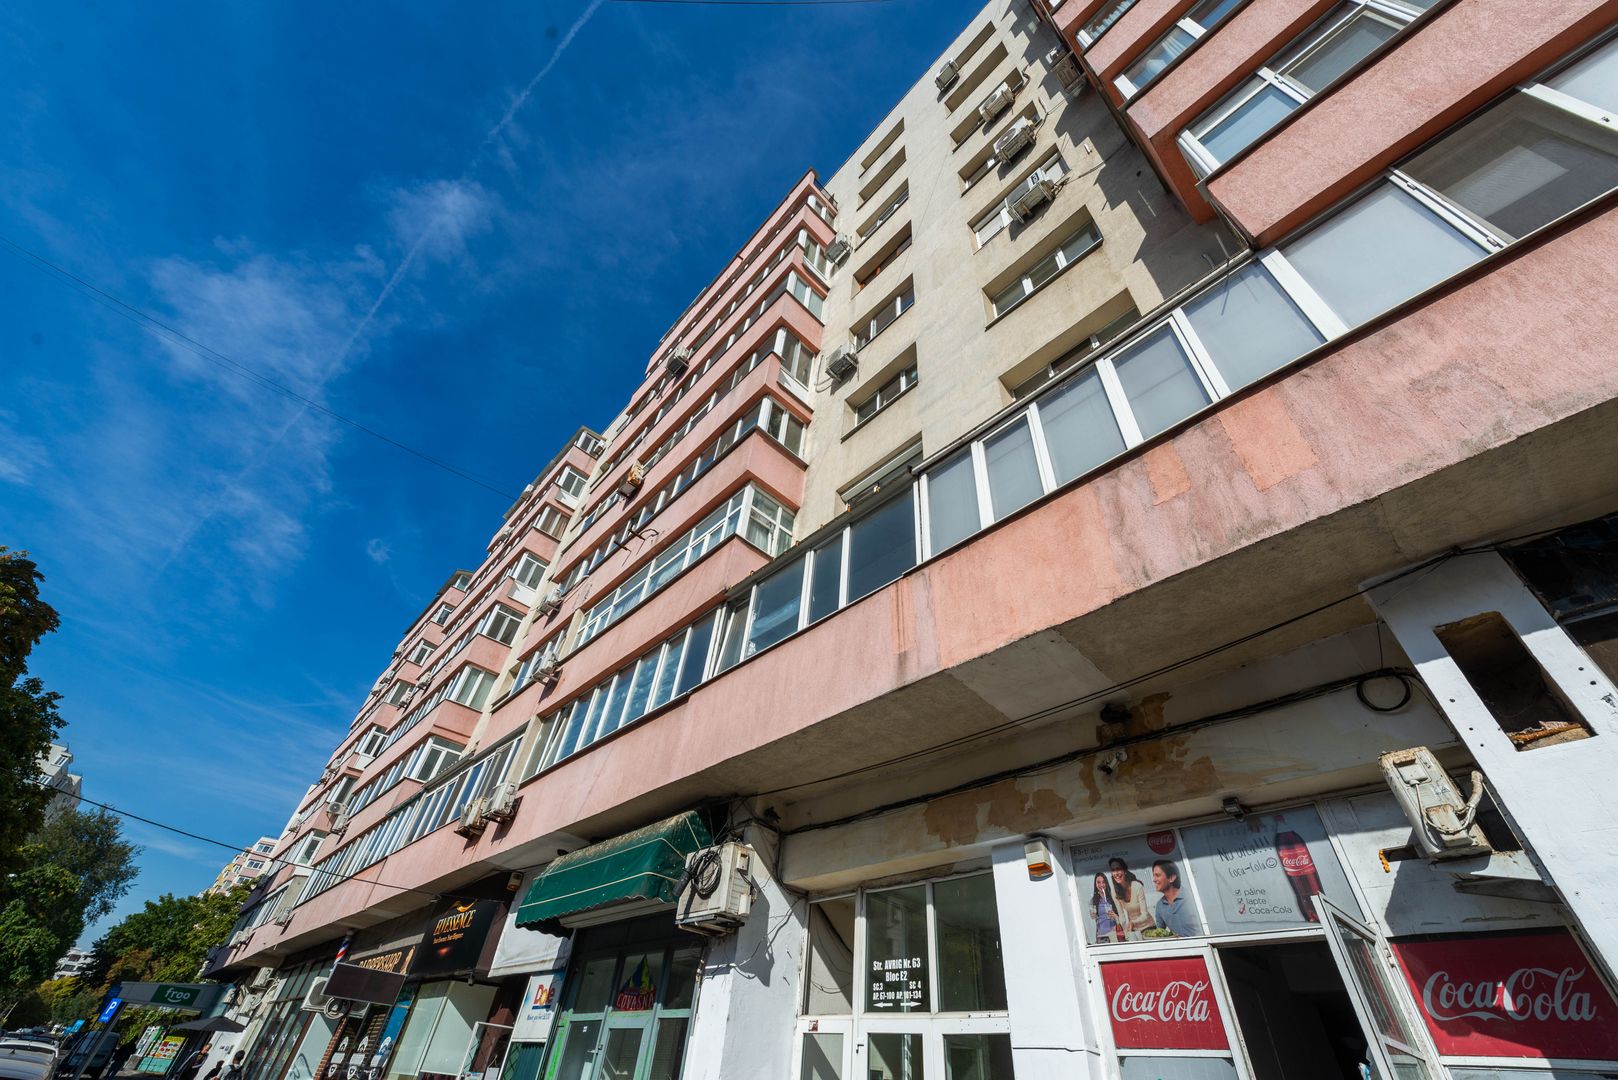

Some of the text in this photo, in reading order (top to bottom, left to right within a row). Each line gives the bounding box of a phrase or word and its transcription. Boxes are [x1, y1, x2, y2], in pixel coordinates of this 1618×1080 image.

[1282, 855, 1309, 867] Coca-Cola
[1245, 897, 1267, 906] lapte
[1248, 905, 1293, 915] Coca-Cola
[873, 958, 921, 970] Str. AVRIG Nr. 63
[885, 971, 907, 981] Bloc E2
[917, 981, 921, 989] 4
[164, 988, 191, 1000] froo
[533, 984, 555, 1005] Dole
[1423, 967, 1597, 1022] Coca-Cola
[1112, 980, 1210, 1022] Coca-Cola
[105, 1001, 118, 1014] P
